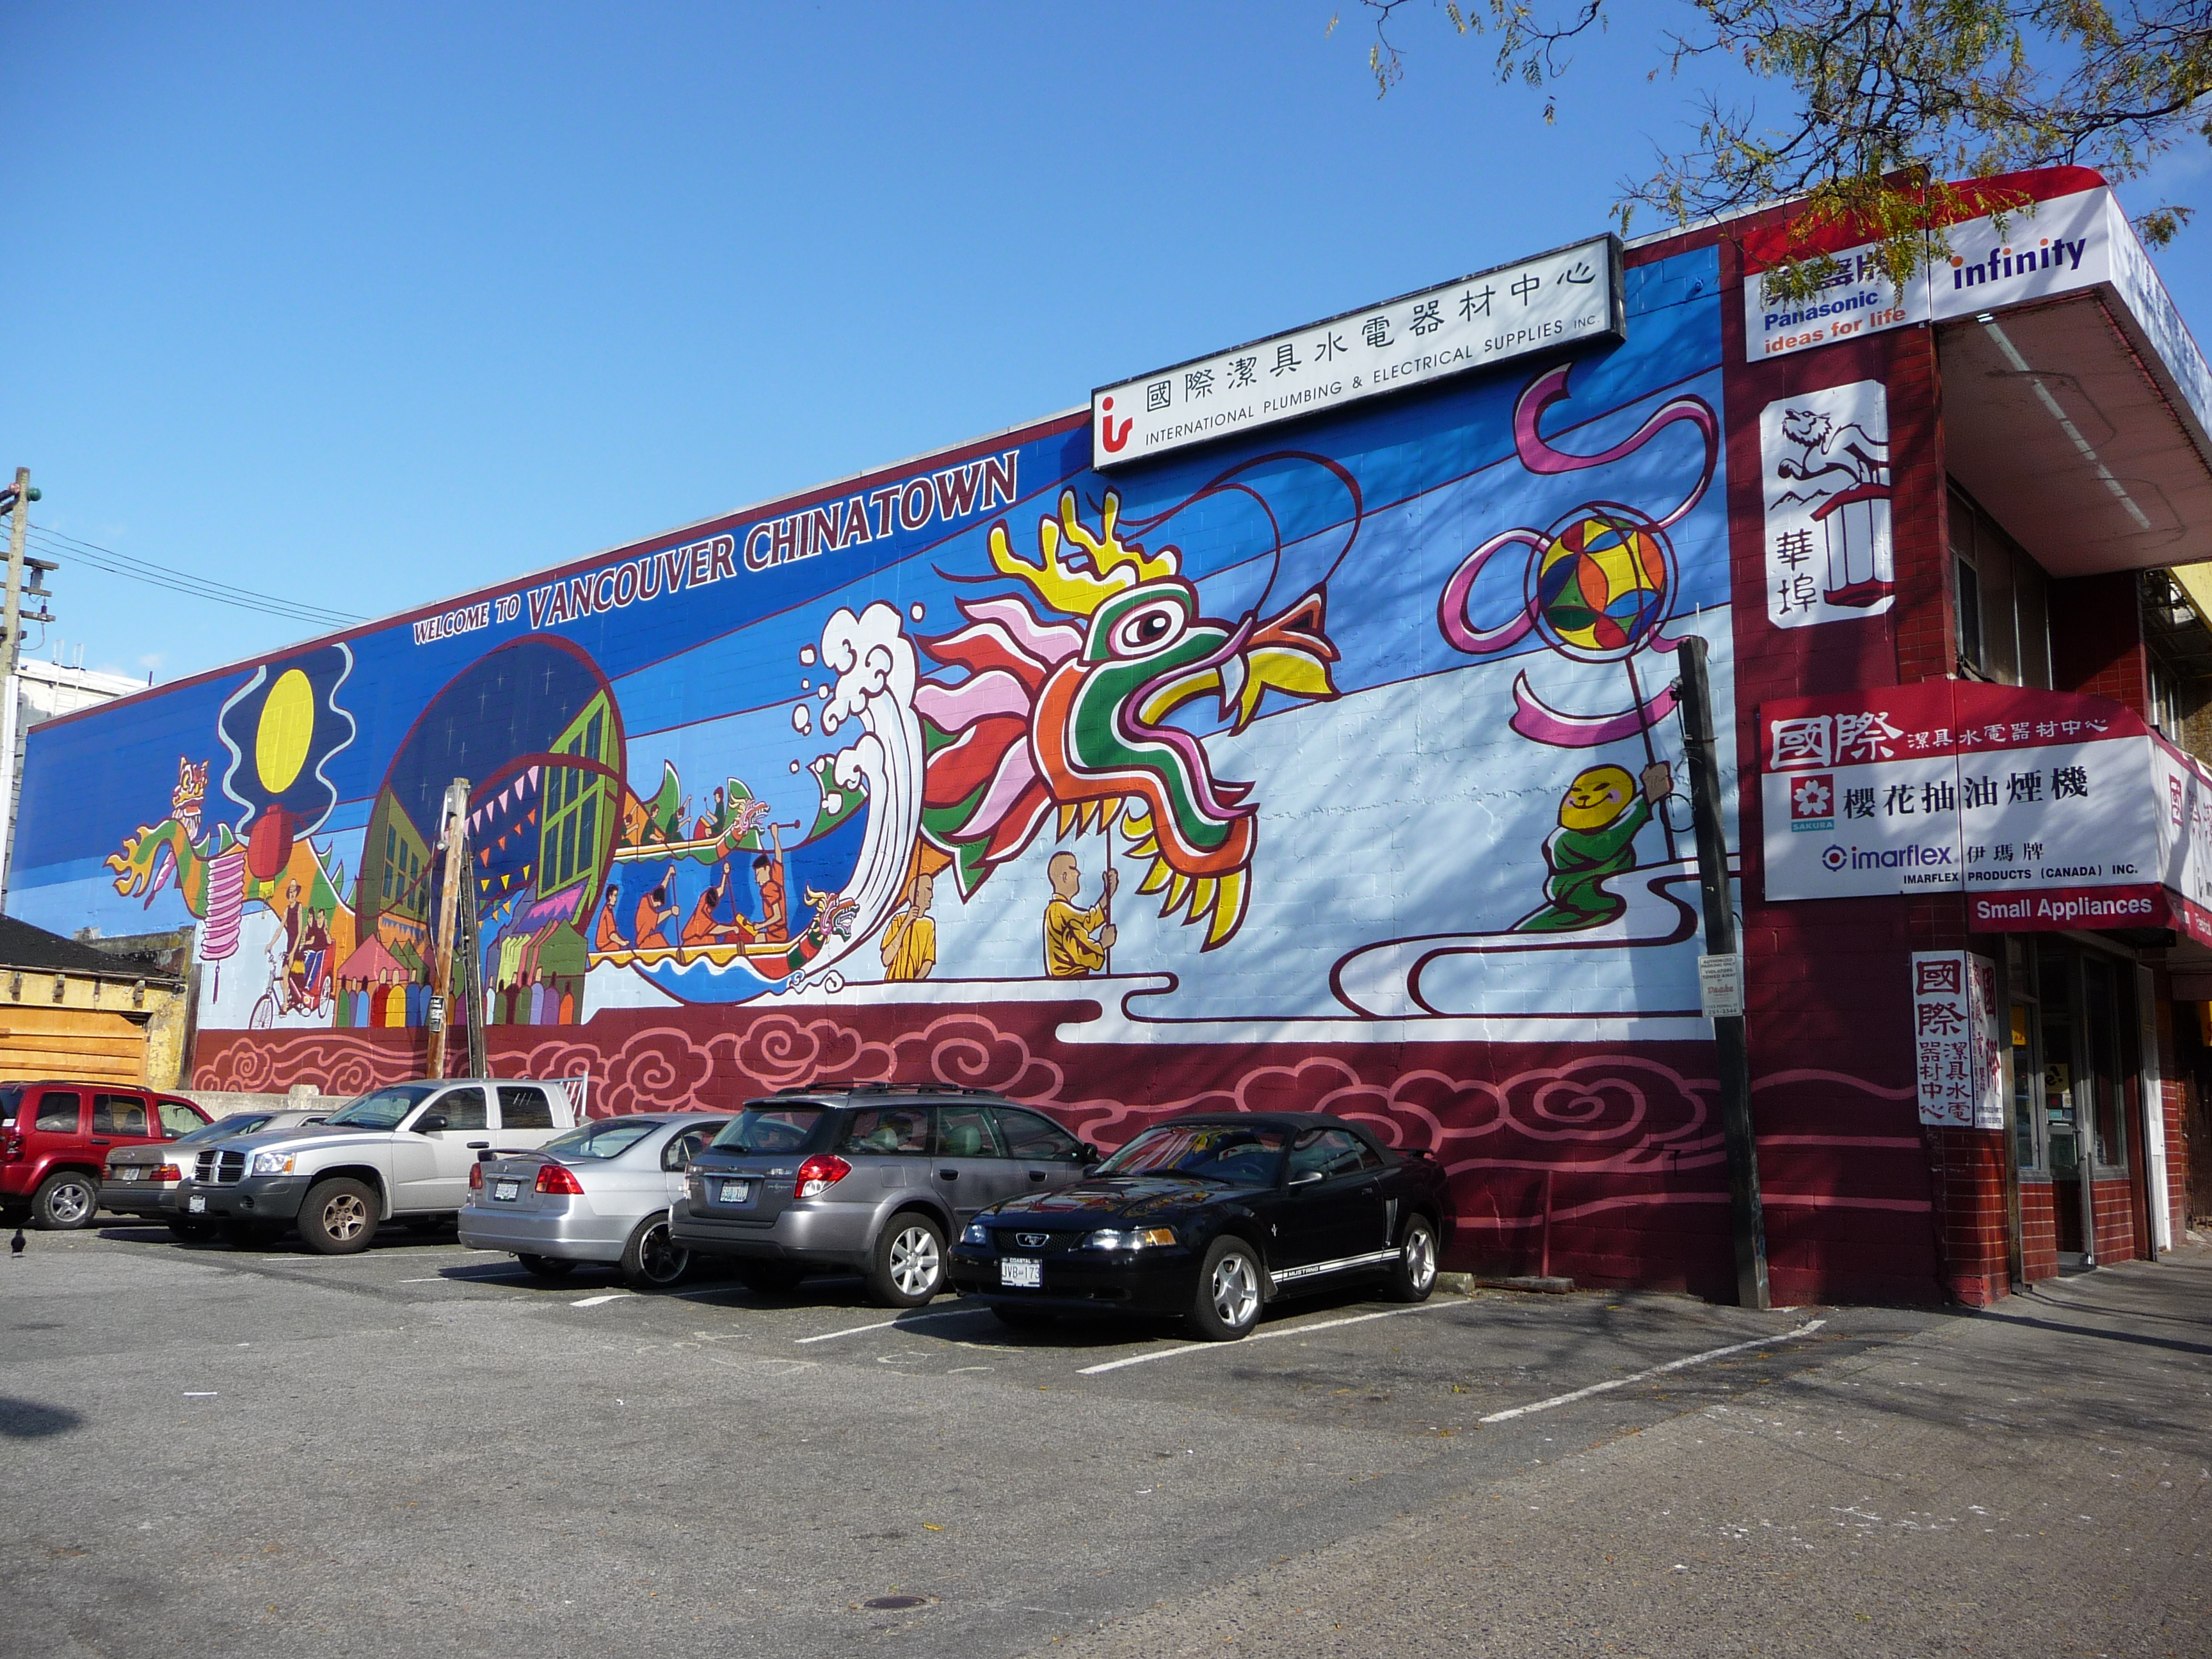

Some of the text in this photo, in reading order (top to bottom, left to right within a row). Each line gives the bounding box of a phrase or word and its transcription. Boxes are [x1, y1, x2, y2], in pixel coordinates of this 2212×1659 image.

[1950, 237, 2086, 290] infinity
[1147, 261, 1596, 413] 國際潔具水電器材中心
[1764, 291, 1879, 330] Panasonic
[1765, 308, 1907, 353] ideas for life
[1145, 315, 1600, 445] INTERNATIONAL PLUMBING & ELECTRICAL SUPPLIES INC.
[413, 450, 1020, 645] WELCOME TO VANCOUVER CHINATOWN
[1775, 528, 1817, 615] 華埠
[1769, 712, 2109, 770] 國際 潔具水電器材中心
[1843, 765, 2088, 819] 櫻花抽油煙機
[1793, 820, 1834, 831] SAKURA
[1851, 844, 1952, 870] imarflex
[1903, 863, 2138, 885] IMARFLEX PRODUCTS (CANADA) INC.
[1967, 842, 2044, 864] 伊瑪牌
[1977, 896, 2152, 920] Small Appliances
[1916, 959, 1968, 1037] 國際
[1919, 1041, 1945, 1119] 器材中心
[1944, 1041, 1971, 1122] 潔具水電
[1288, 1266, 1319, 1277] MUSTANG
